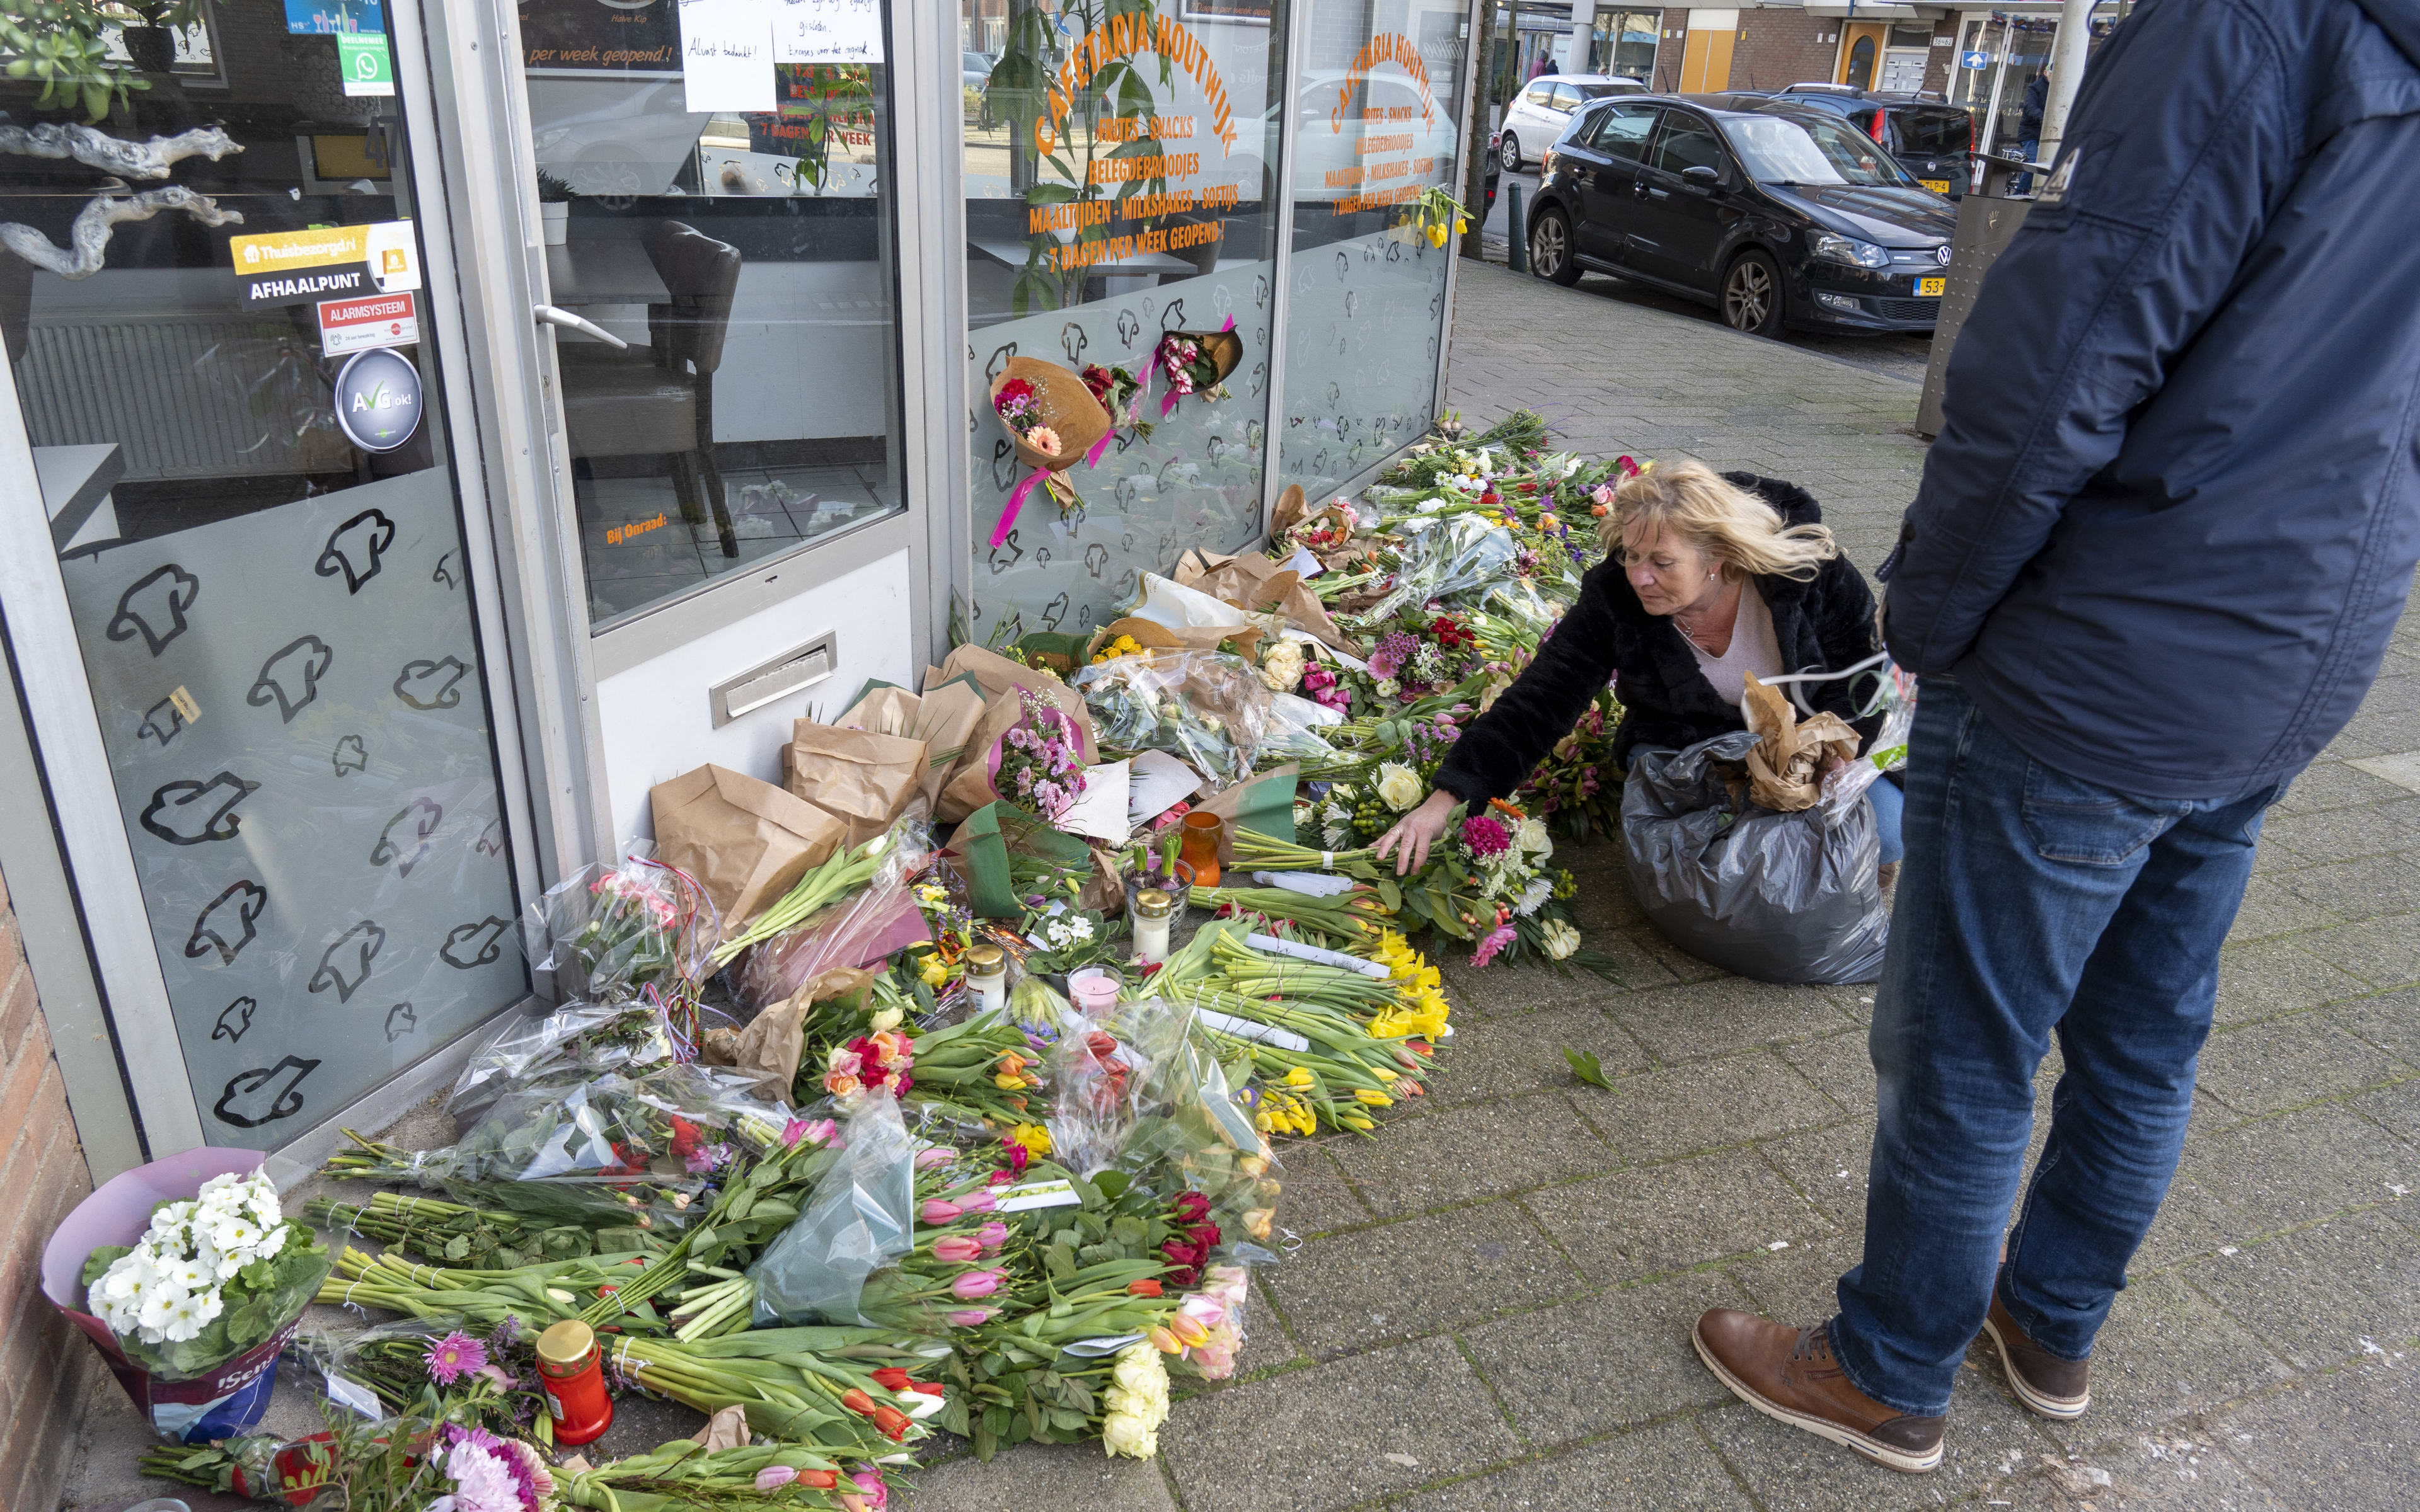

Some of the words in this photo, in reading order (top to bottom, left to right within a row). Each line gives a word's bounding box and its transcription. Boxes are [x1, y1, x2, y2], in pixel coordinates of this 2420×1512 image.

[611, 14, 632, 23] Halve
[634, 14, 647, 25] Kip
[1219, 5, 1231, 13] per
[1233, 6, 1252, 15] week
[341, 35, 384, 45] DEELNEMER
[688, 37, 717, 57] Alvast
[529, 49, 557, 64] per
[560, 45, 599, 61] week
[602, 45, 665, 66] geopend
[1035, 11, 1149, 157] CAFETARIA
[1156, 13, 1238, 159] HOUTWIJK
[1331, 32, 1392, 135] CAFETARIA
[1395, 33, 1436, 138] HOUTWIJK
[1362, 106, 1384, 125] FRITES
[1388, 105, 1412, 124] SNACKS
[364, 115, 400, 169] 47
[1098, 117, 1139, 144] FRITES
[1149, 115, 1193, 141] SNACKS
[1356, 133, 1414, 155] BELEGDEBROODJES
[1088, 152, 1199, 185] BELEGDEBROODJES
[1325, 166, 1366, 190] MAALTIJDEN
[1371, 159, 1409, 181] MILKSHAKES
[1412, 156, 1434, 177] SOFTIJS
[1029, 199, 1110, 235] MAALTIJDEN
[1122, 189, 1193, 221] MILKSHAKES
[1202, 183, 1238, 212] SOFTIJS
[1333, 198, 1338, 217] 7
[1339, 195, 1362, 215] DAGEN
[1363, 192, 1375, 211] PER
[1376, 187, 1394, 209] WEEK
[1395, 183, 1421, 205] GEOPEND
[260, 238, 357, 260] Thuisbezorgd.nl
[1049, 247, 1058, 273] 7
[1062, 239, 1106, 272] DAGEN
[1109, 235, 1133, 261] PER
[1136, 228, 1168, 256] WEEK
[1170, 220, 1219, 250] GEOPEND
[251, 272, 360, 300] AFHAALPUNT
[330, 301, 406, 322] ALARMSYSTEEM
[395, 394, 412, 406] ok!
[606, 526, 623, 546] Bij
[625, 512, 668, 538] Onraad:
